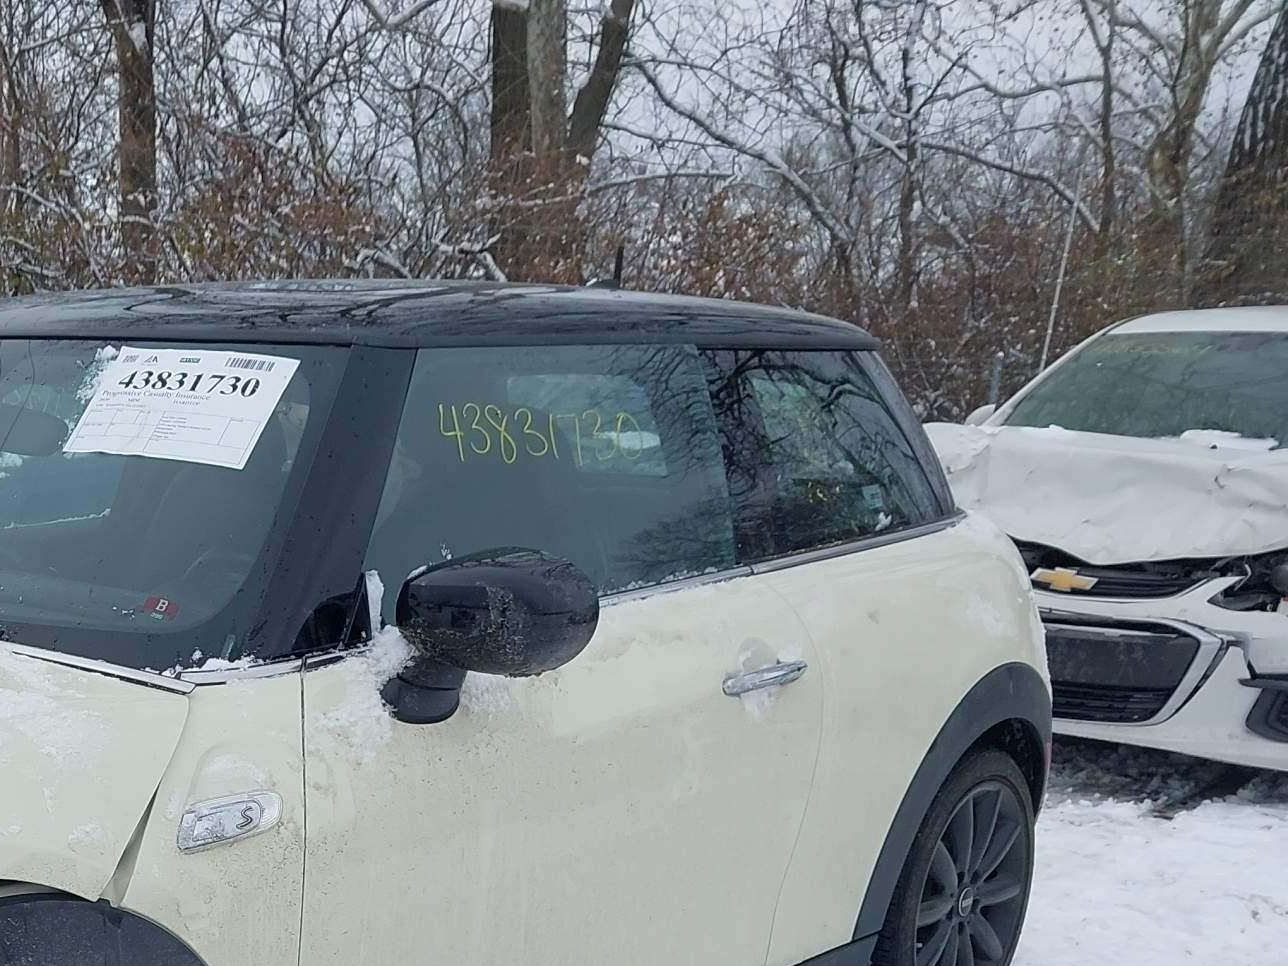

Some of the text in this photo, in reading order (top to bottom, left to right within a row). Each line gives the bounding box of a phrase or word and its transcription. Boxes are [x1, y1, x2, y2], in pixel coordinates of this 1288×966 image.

[118, 370, 260, 398] 43831730
[438, 402, 644, 467] 43831730
[155, 598, 169, 612] B
[236, 805, 254, 830] S
